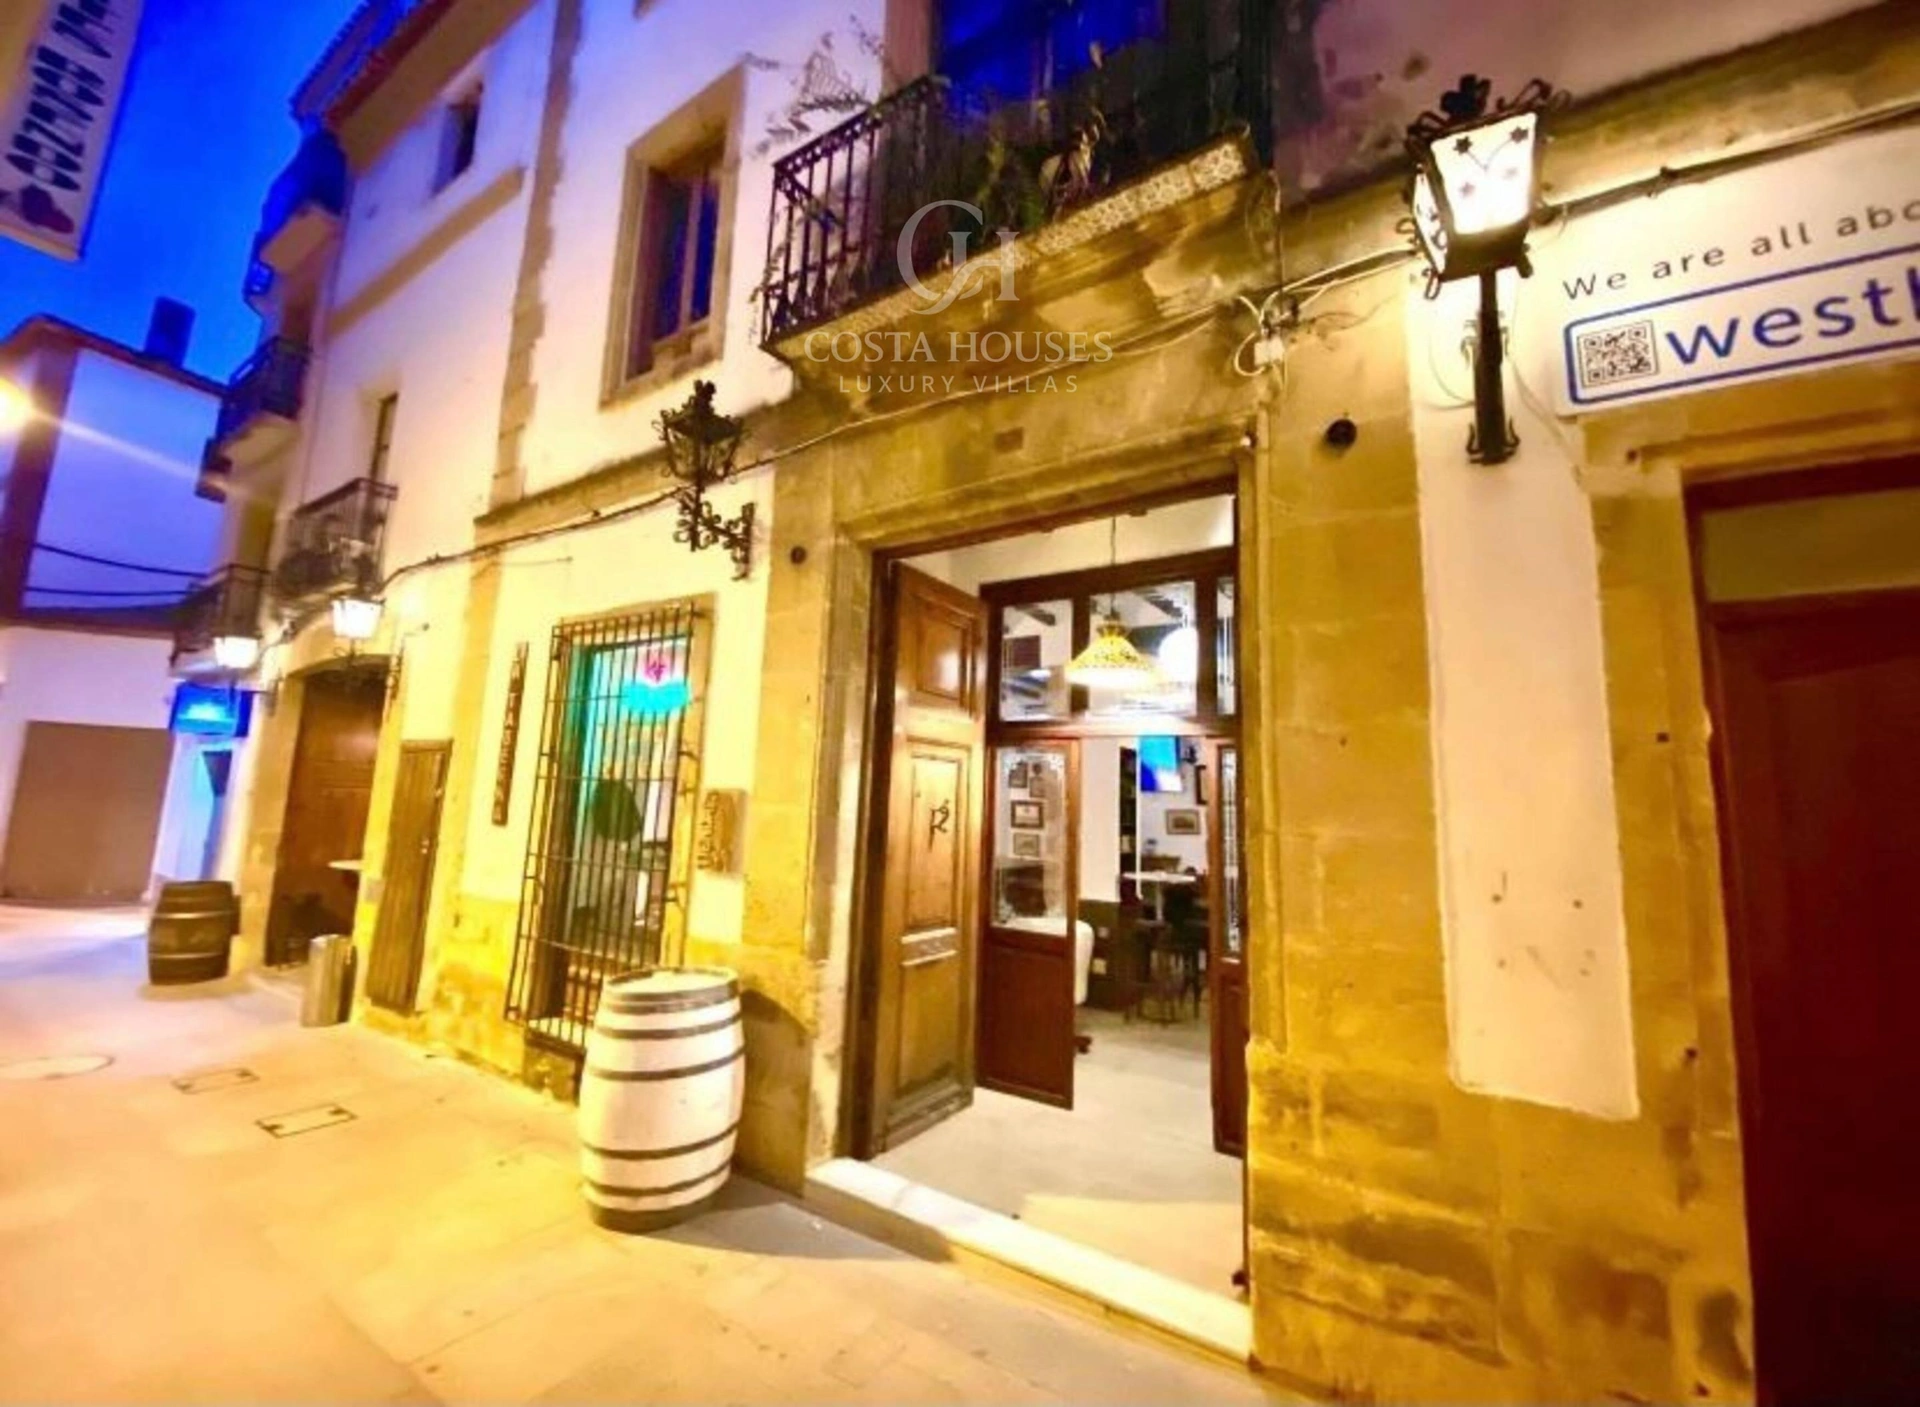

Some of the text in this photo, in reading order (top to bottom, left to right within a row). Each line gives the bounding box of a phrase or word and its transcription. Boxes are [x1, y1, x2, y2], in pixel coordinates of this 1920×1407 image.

[1563, 274, 1627, 300] We
[1652, 247, 1725, 279] are
[1750, 222, 1813, 256] all
